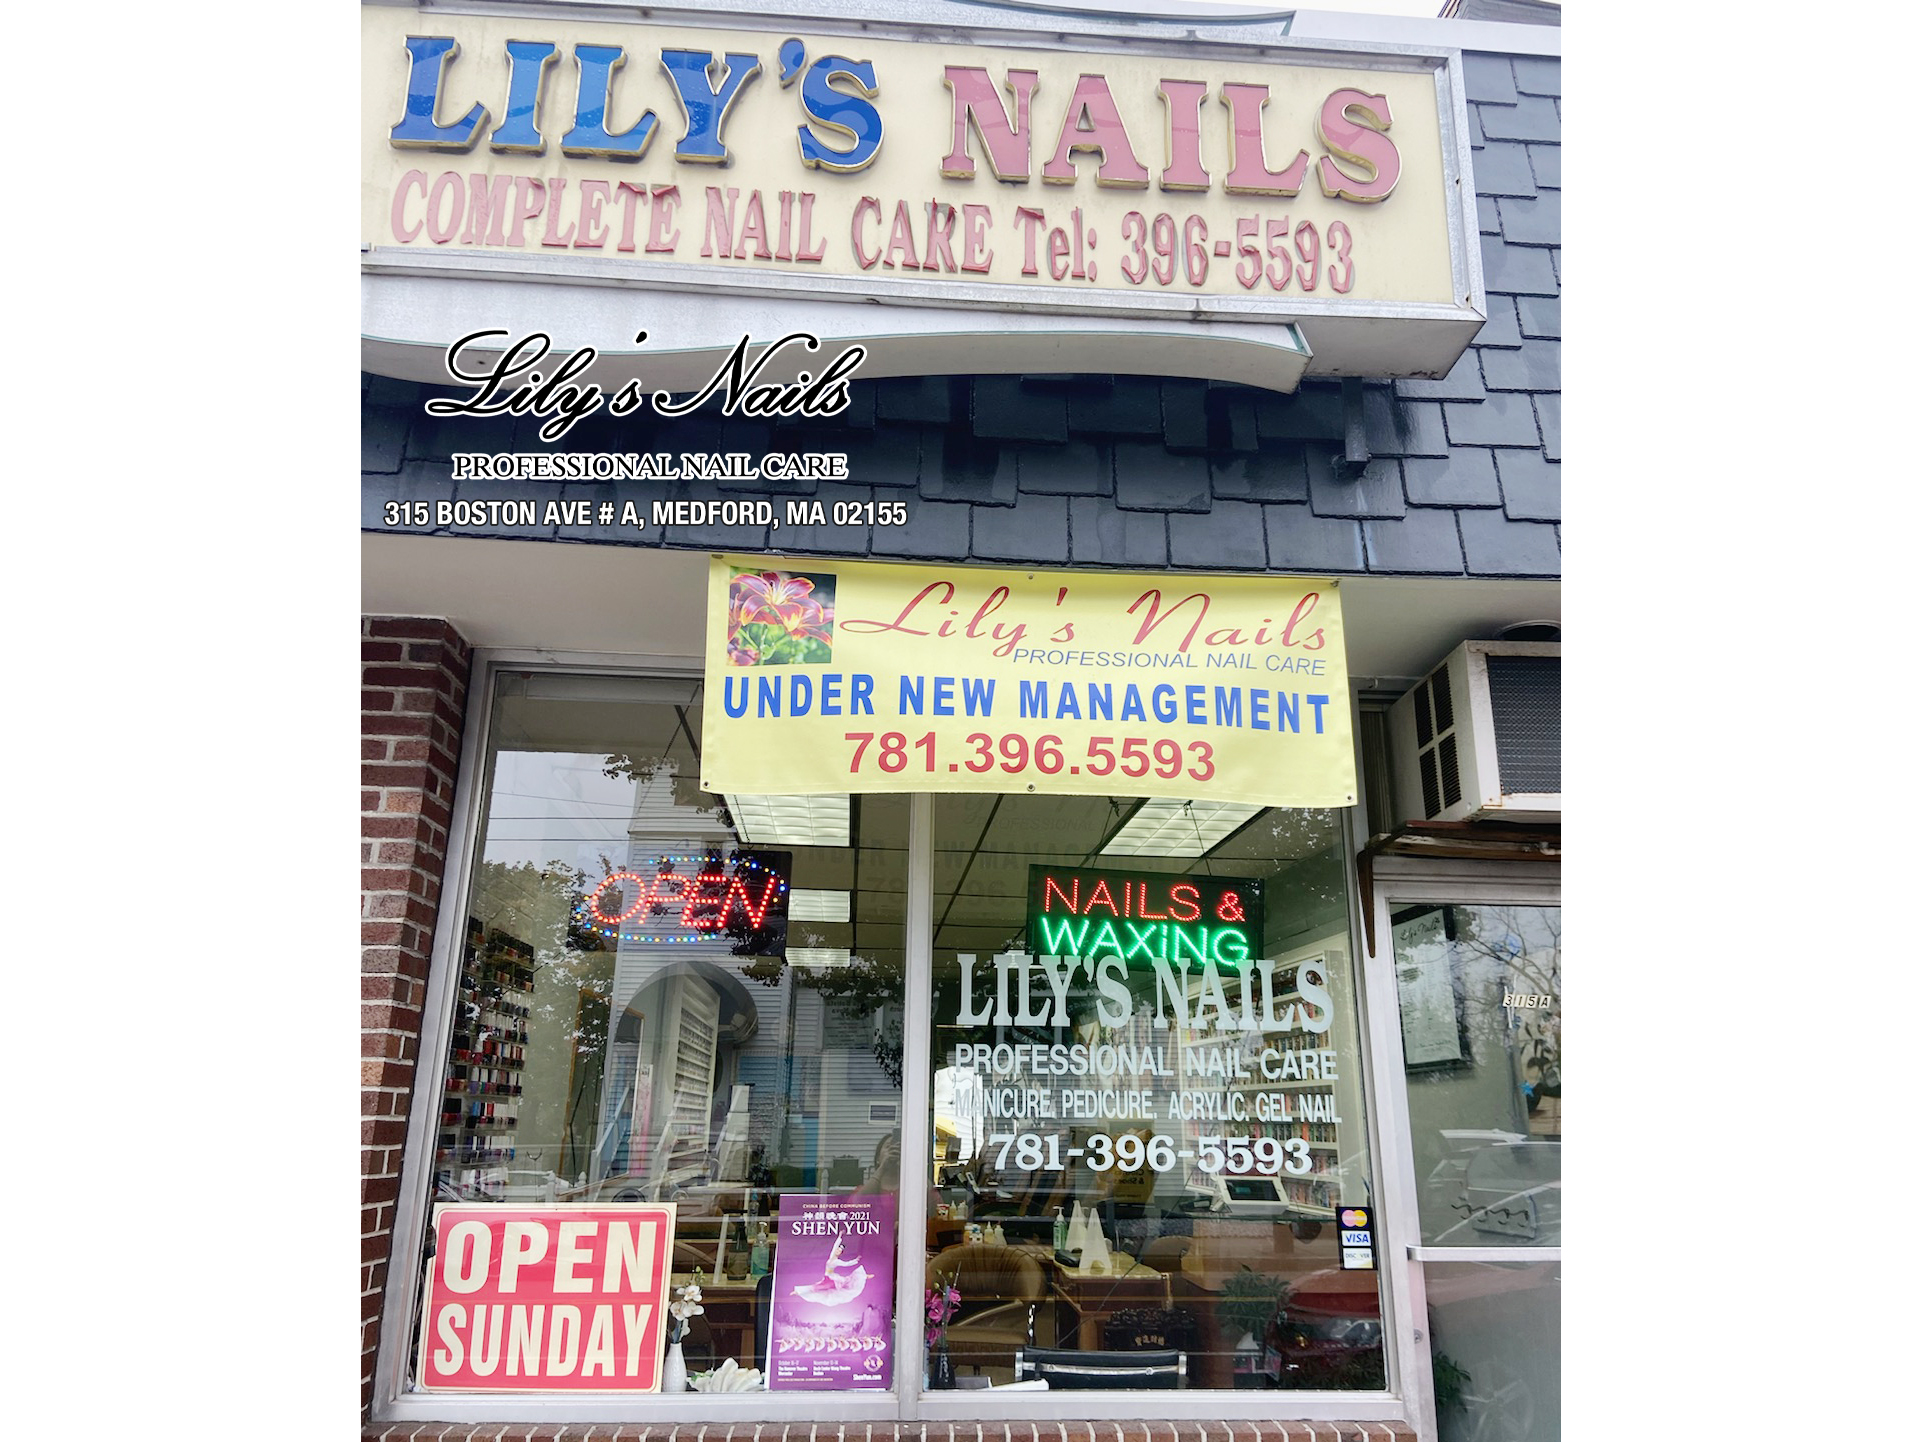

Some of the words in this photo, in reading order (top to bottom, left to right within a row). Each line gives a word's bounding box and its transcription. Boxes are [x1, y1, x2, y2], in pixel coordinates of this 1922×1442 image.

[388, 35, 885, 174] LILY'S
[939, 65, 1402, 203] NAILS
[391, 169, 681, 253] COMPLETE
[700, 186, 828, 262] NAIL
[851, 196, 993, 274] CARE
[1014, 205, 1097, 282] Tel:
[1121, 211, 1355, 294] 396-5593
[839, 581, 1075, 658] Lily's
[1127, 588, 1327, 653] Nails
[1012, 648, 1198, 669] PROFESSIONAL
[1205, 653, 1260, 671] NAIL
[1265, 655, 1327, 677] CARE
[723, 673, 875, 719] UNDER
[899, 675, 996, 718] NEW
[1019, 680, 1329, 734] MANAGEMENT
[844, 731, 1217, 781] 781.396.5593
[590, 872, 776, 928] OPEN
[1044, 877, 1202, 922] NAILS
[1217, 891, 1247, 922] &
[956, 952, 1134, 1028] LILY'S
[1152, 956, 1335, 1034] NAILS
[955, 1043, 1174, 1076] PROFESSIONAL
[1186, 1048, 1251, 1078] NAIL
[1260, 1048, 1339, 1080] CARE
[1256, 1092, 1293, 1123] GEL
[1298, 1093, 1342, 1124] NAIL
[988, 1133, 1314, 1175] 781-396-5593
[791, 1221, 839, 1236] SHEN
[843, 1220, 881, 1235] YUN
[849, 1211, 870, 1221] 2021
[1345, 1233, 1369, 1243] VISA
[443, 1220, 658, 1294] OPEN
[433, 1303, 653, 1378] SUNDAY
